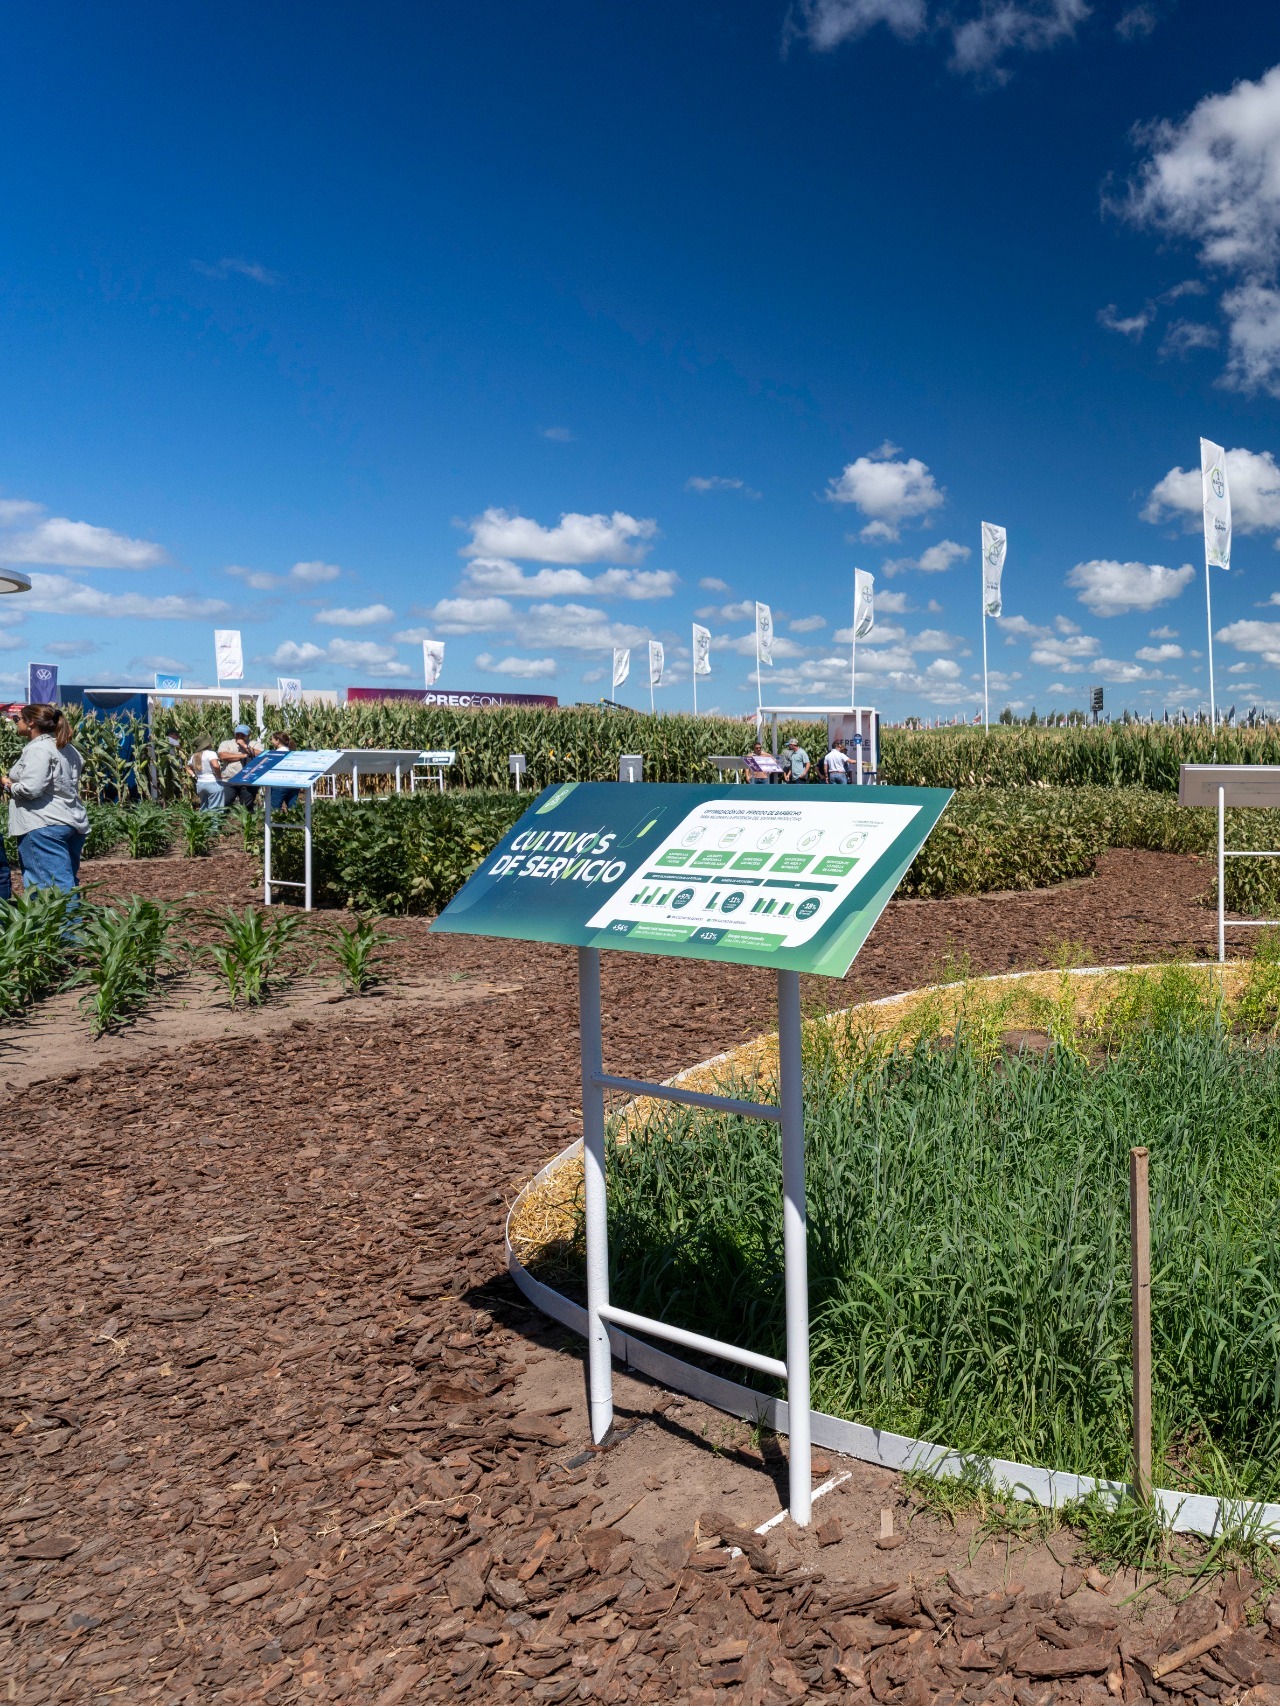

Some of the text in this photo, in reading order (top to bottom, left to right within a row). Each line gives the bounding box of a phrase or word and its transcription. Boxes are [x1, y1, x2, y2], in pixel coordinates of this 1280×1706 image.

[425, 694, 502, 707] PRECEON
[511, 830, 617, 855] CULTIVOS
[488, 855, 627, 884] DE SERVICIO
[700, 932, 718, 940] +13%
